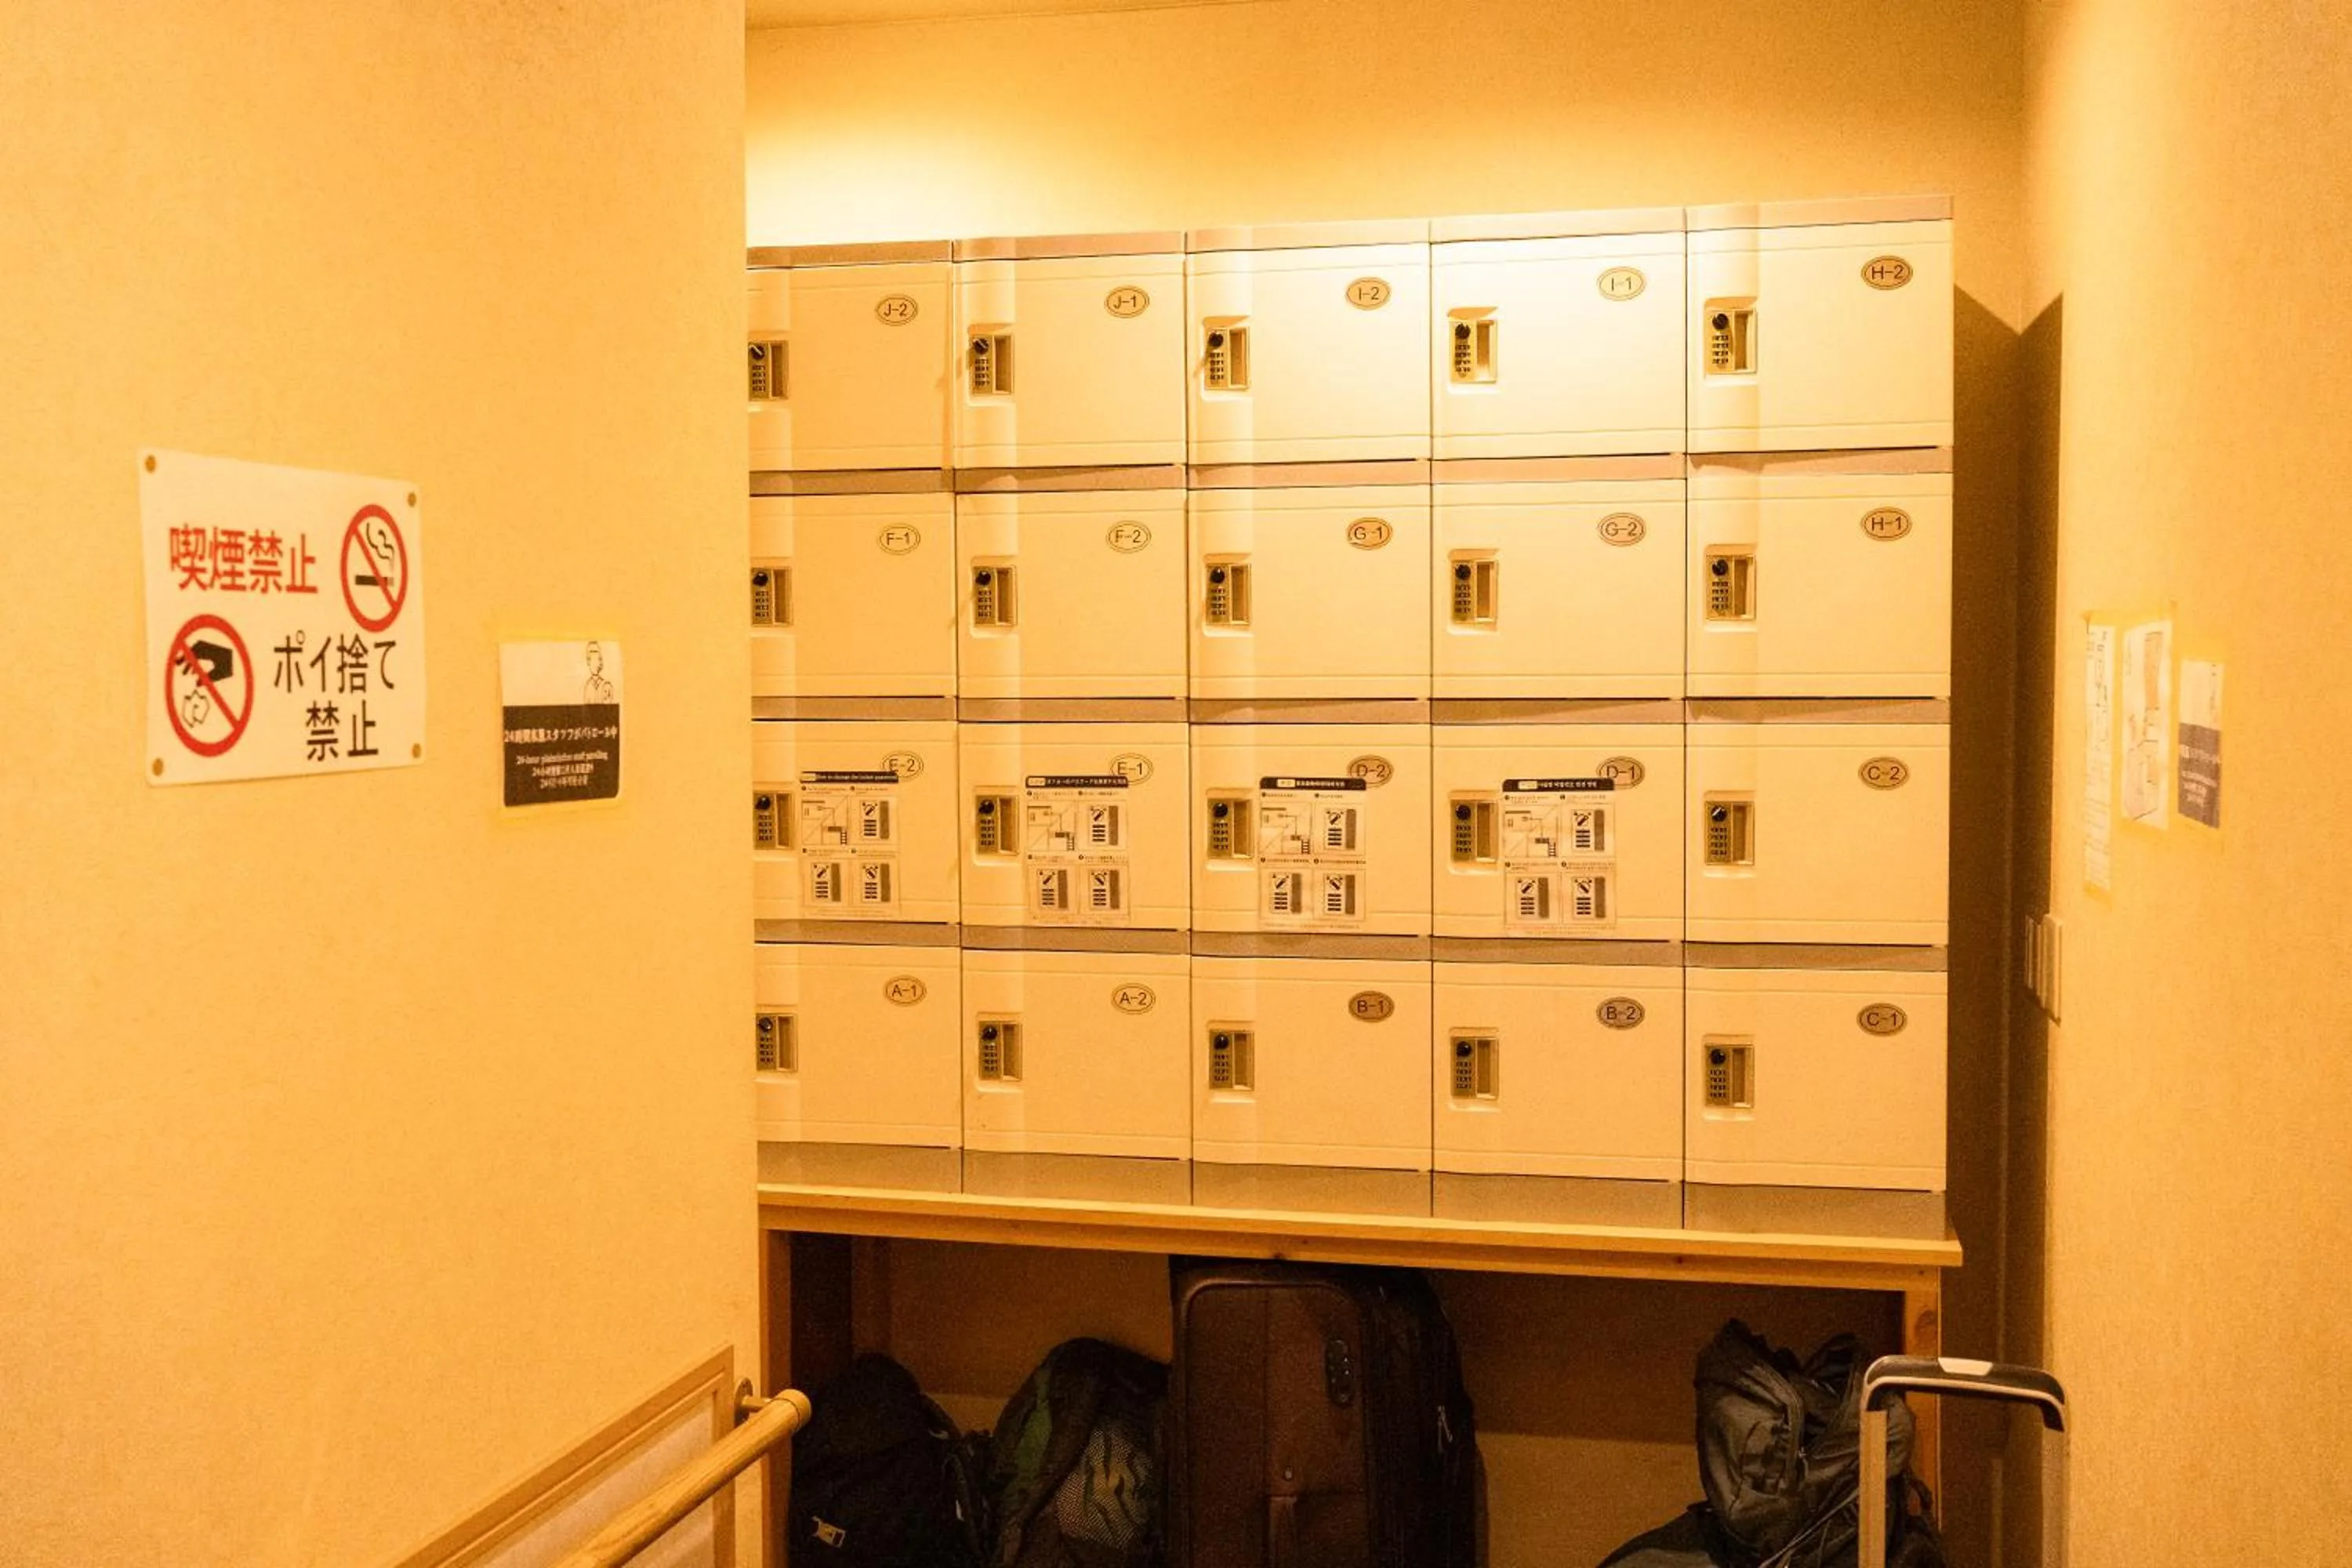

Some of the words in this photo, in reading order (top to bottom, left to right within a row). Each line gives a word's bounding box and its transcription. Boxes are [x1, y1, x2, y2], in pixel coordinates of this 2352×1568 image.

[1871, 265, 1904, 280] H-2
[1611, 277, 1632, 292] I-1
[1358, 286, 1379, 300] I-2
[1113, 295, 1136, 309] J-1
[884, 303, 907, 317] J-2
[1606, 521, 1637, 537] G-2
[1871, 516, 1901, 531] H-1
[886, 532, 909, 546] F-1
[1115, 529, 1142, 543] F-2
[1354, 526, 1382, 540] G-1
[169, 524, 319, 594] 喫煙禁止
[274, 630, 397, 694] ポイ捨て
[306, 699, 379, 762] 禁止
[888, 758, 915, 772] E-2
[1117, 761, 1142, 775] E-1
[1357, 764, 1385, 779] D-2
[1606, 764, 1635, 779] D-1
[1868, 766, 1900, 781] C-2
[891, 984, 916, 998] A-1
[1119, 992, 1147, 1006] A-2
[1357, 1000, 1384, 1014] B-1
[1606, 1006, 1635, 1021] B-2
[1867, 1012, 1896, 1027] C-1
